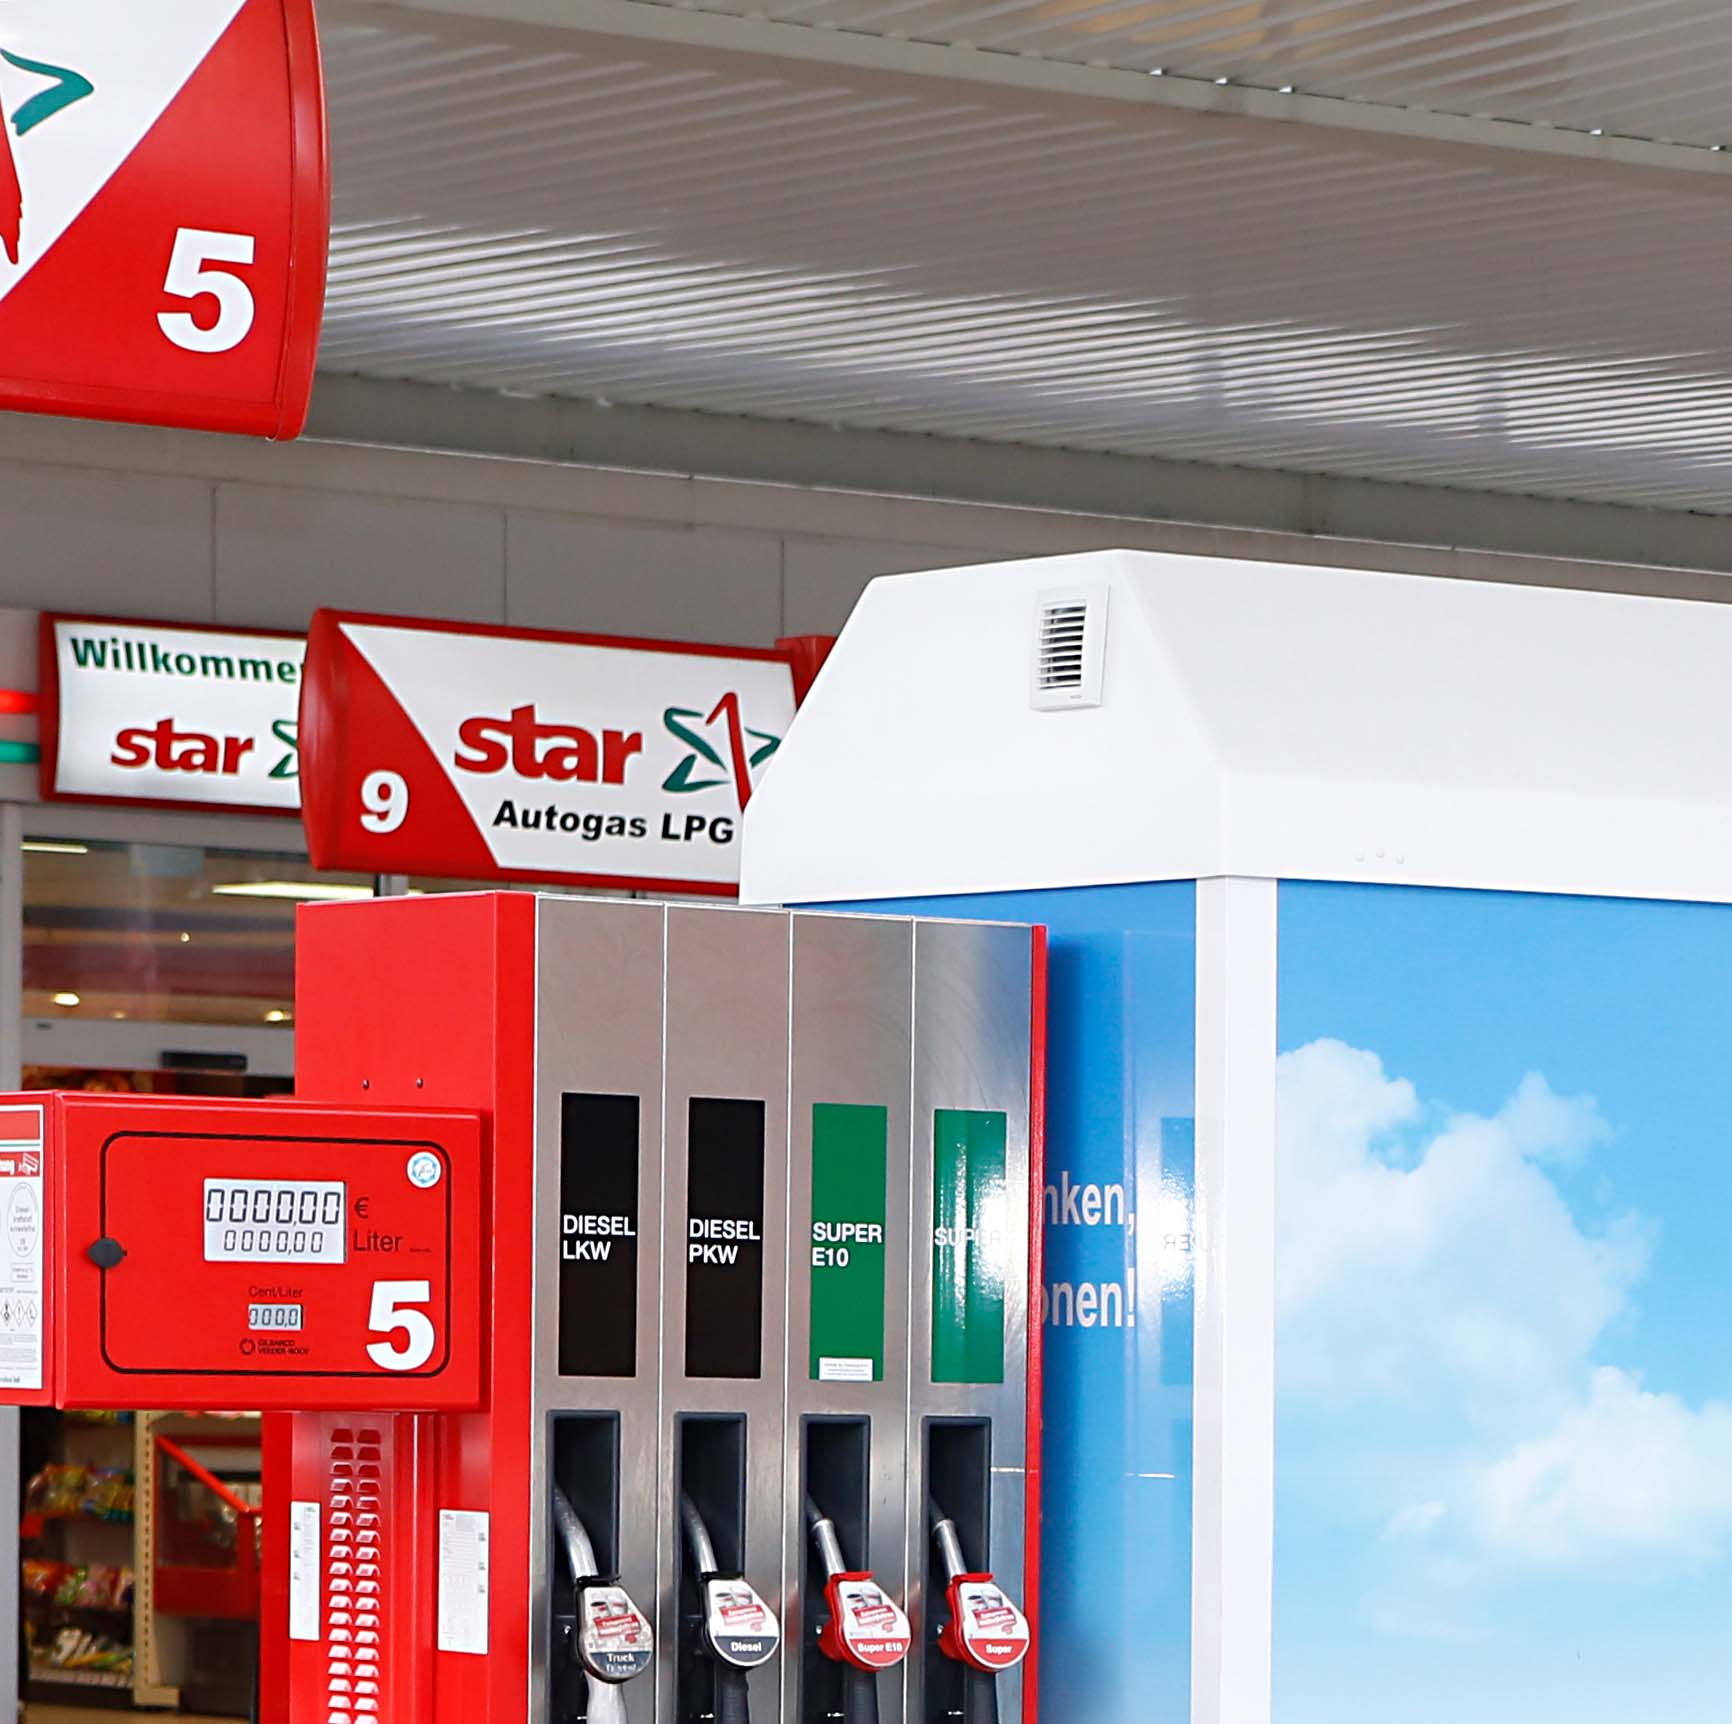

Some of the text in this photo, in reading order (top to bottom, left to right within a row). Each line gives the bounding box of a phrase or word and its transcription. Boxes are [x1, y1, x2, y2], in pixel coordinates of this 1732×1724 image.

[156, 228, 255, 352] 5
[70, 637, 302, 684] Willkomme
[111, 717, 253, 779] star
[455, 704, 642, 785] star
[359, 770, 409, 834] 9
[493, 799, 735, 844] Autogas LPG
[354, 1197, 369, 1218] €
[563, 1214, 636, 1236] DIESEL
[689, 1219, 760, 1241] DIESEL
[812, 1222, 883, 1243] SUPER
[353, 1231, 403, 1251] Liter
[562, 1241, 611, 1260] LKW
[688, 1245, 738, 1264] PKW
[812, 1247, 849, 1267] E10
[249, 1285, 303, 1298] Cent/Liter
[365, 1280, 436, 1371] 5
[731, 1642, 761, 1652] Diesel
[858, 1643, 902, 1654] Super E10
[986, 1644, 1012, 1654] Super
[607, 1653, 635, 1663] Truck
